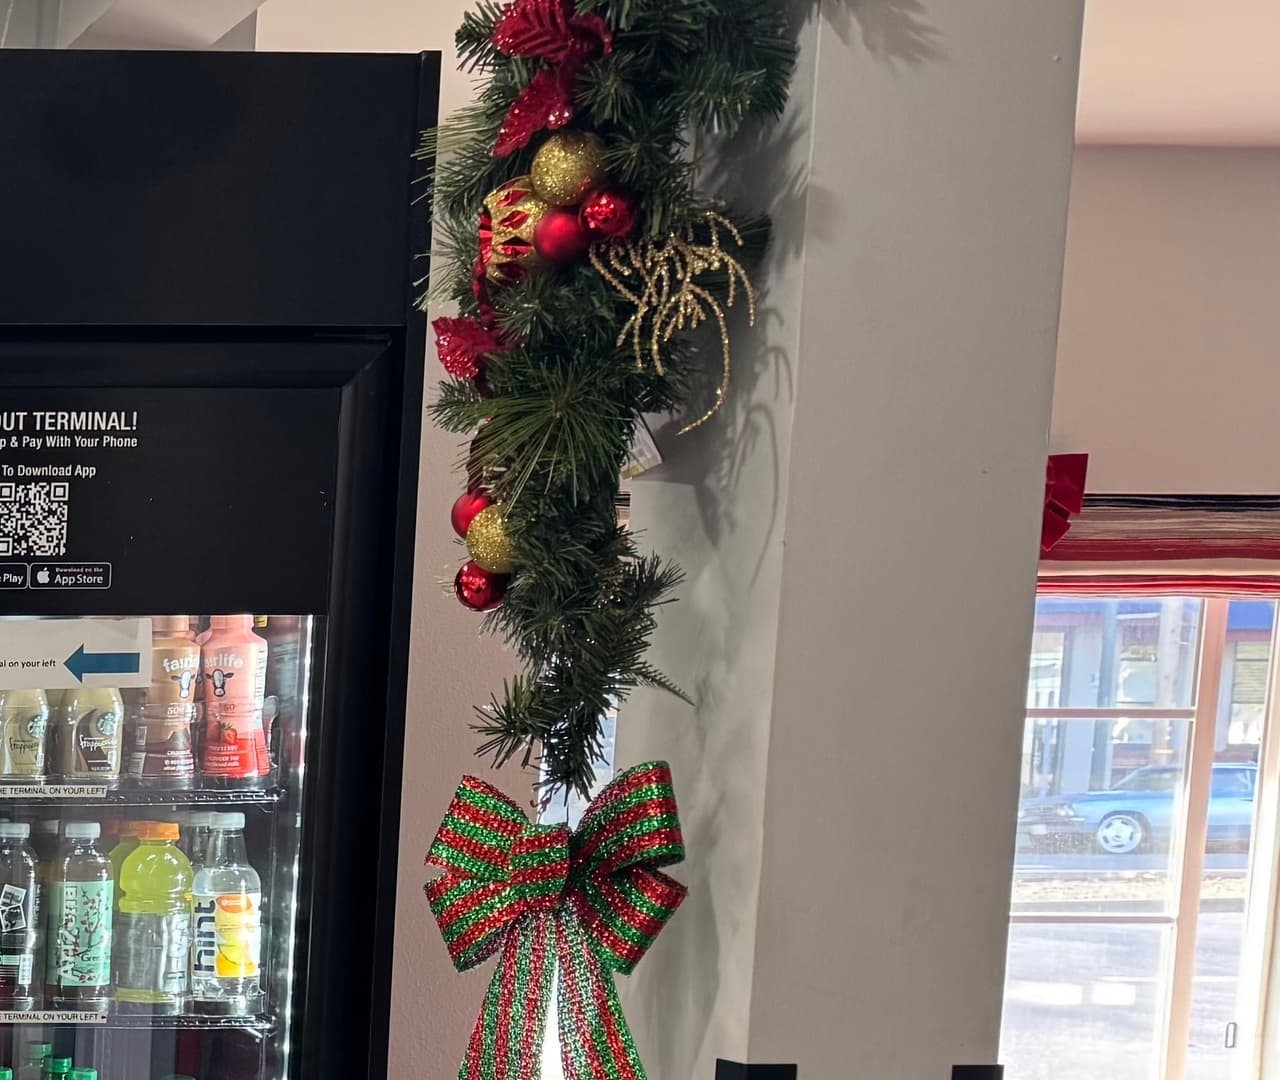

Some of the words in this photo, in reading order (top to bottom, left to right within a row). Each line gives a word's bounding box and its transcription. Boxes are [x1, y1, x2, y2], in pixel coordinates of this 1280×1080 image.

[33, 411, 138, 431] TERMINAL!
[10, 436, 19, 448] &
[23, 436, 42, 450] Pay
[46, 436, 71, 448] With
[74, 436, 99, 448] Your
[103, 436, 138, 448] Phone
[2, 465, 14, 477] To
[17, 464, 71, 477] Download
[74, 465, 97, 479] App
[3, 573, 24, 585] Play
[54, 574, 76, 586] App
[77, 574, 104, 584] Store
[21, 661, 41, 669] your
[10, 787, 47, 795] TERMINAL
[49, 786, 61, 795] ON
[63, 786, 82, 795] YOUR
[87, 786, 106, 795] LEFT
[194, 899, 216, 974] hint
[4, 1013, 41, 1021] TERMINAL
[43, 1013, 54, 1021] ON
[56, 1013, 78, 1021] YOUR
[80, 1013, 98, 1021] LEFT
